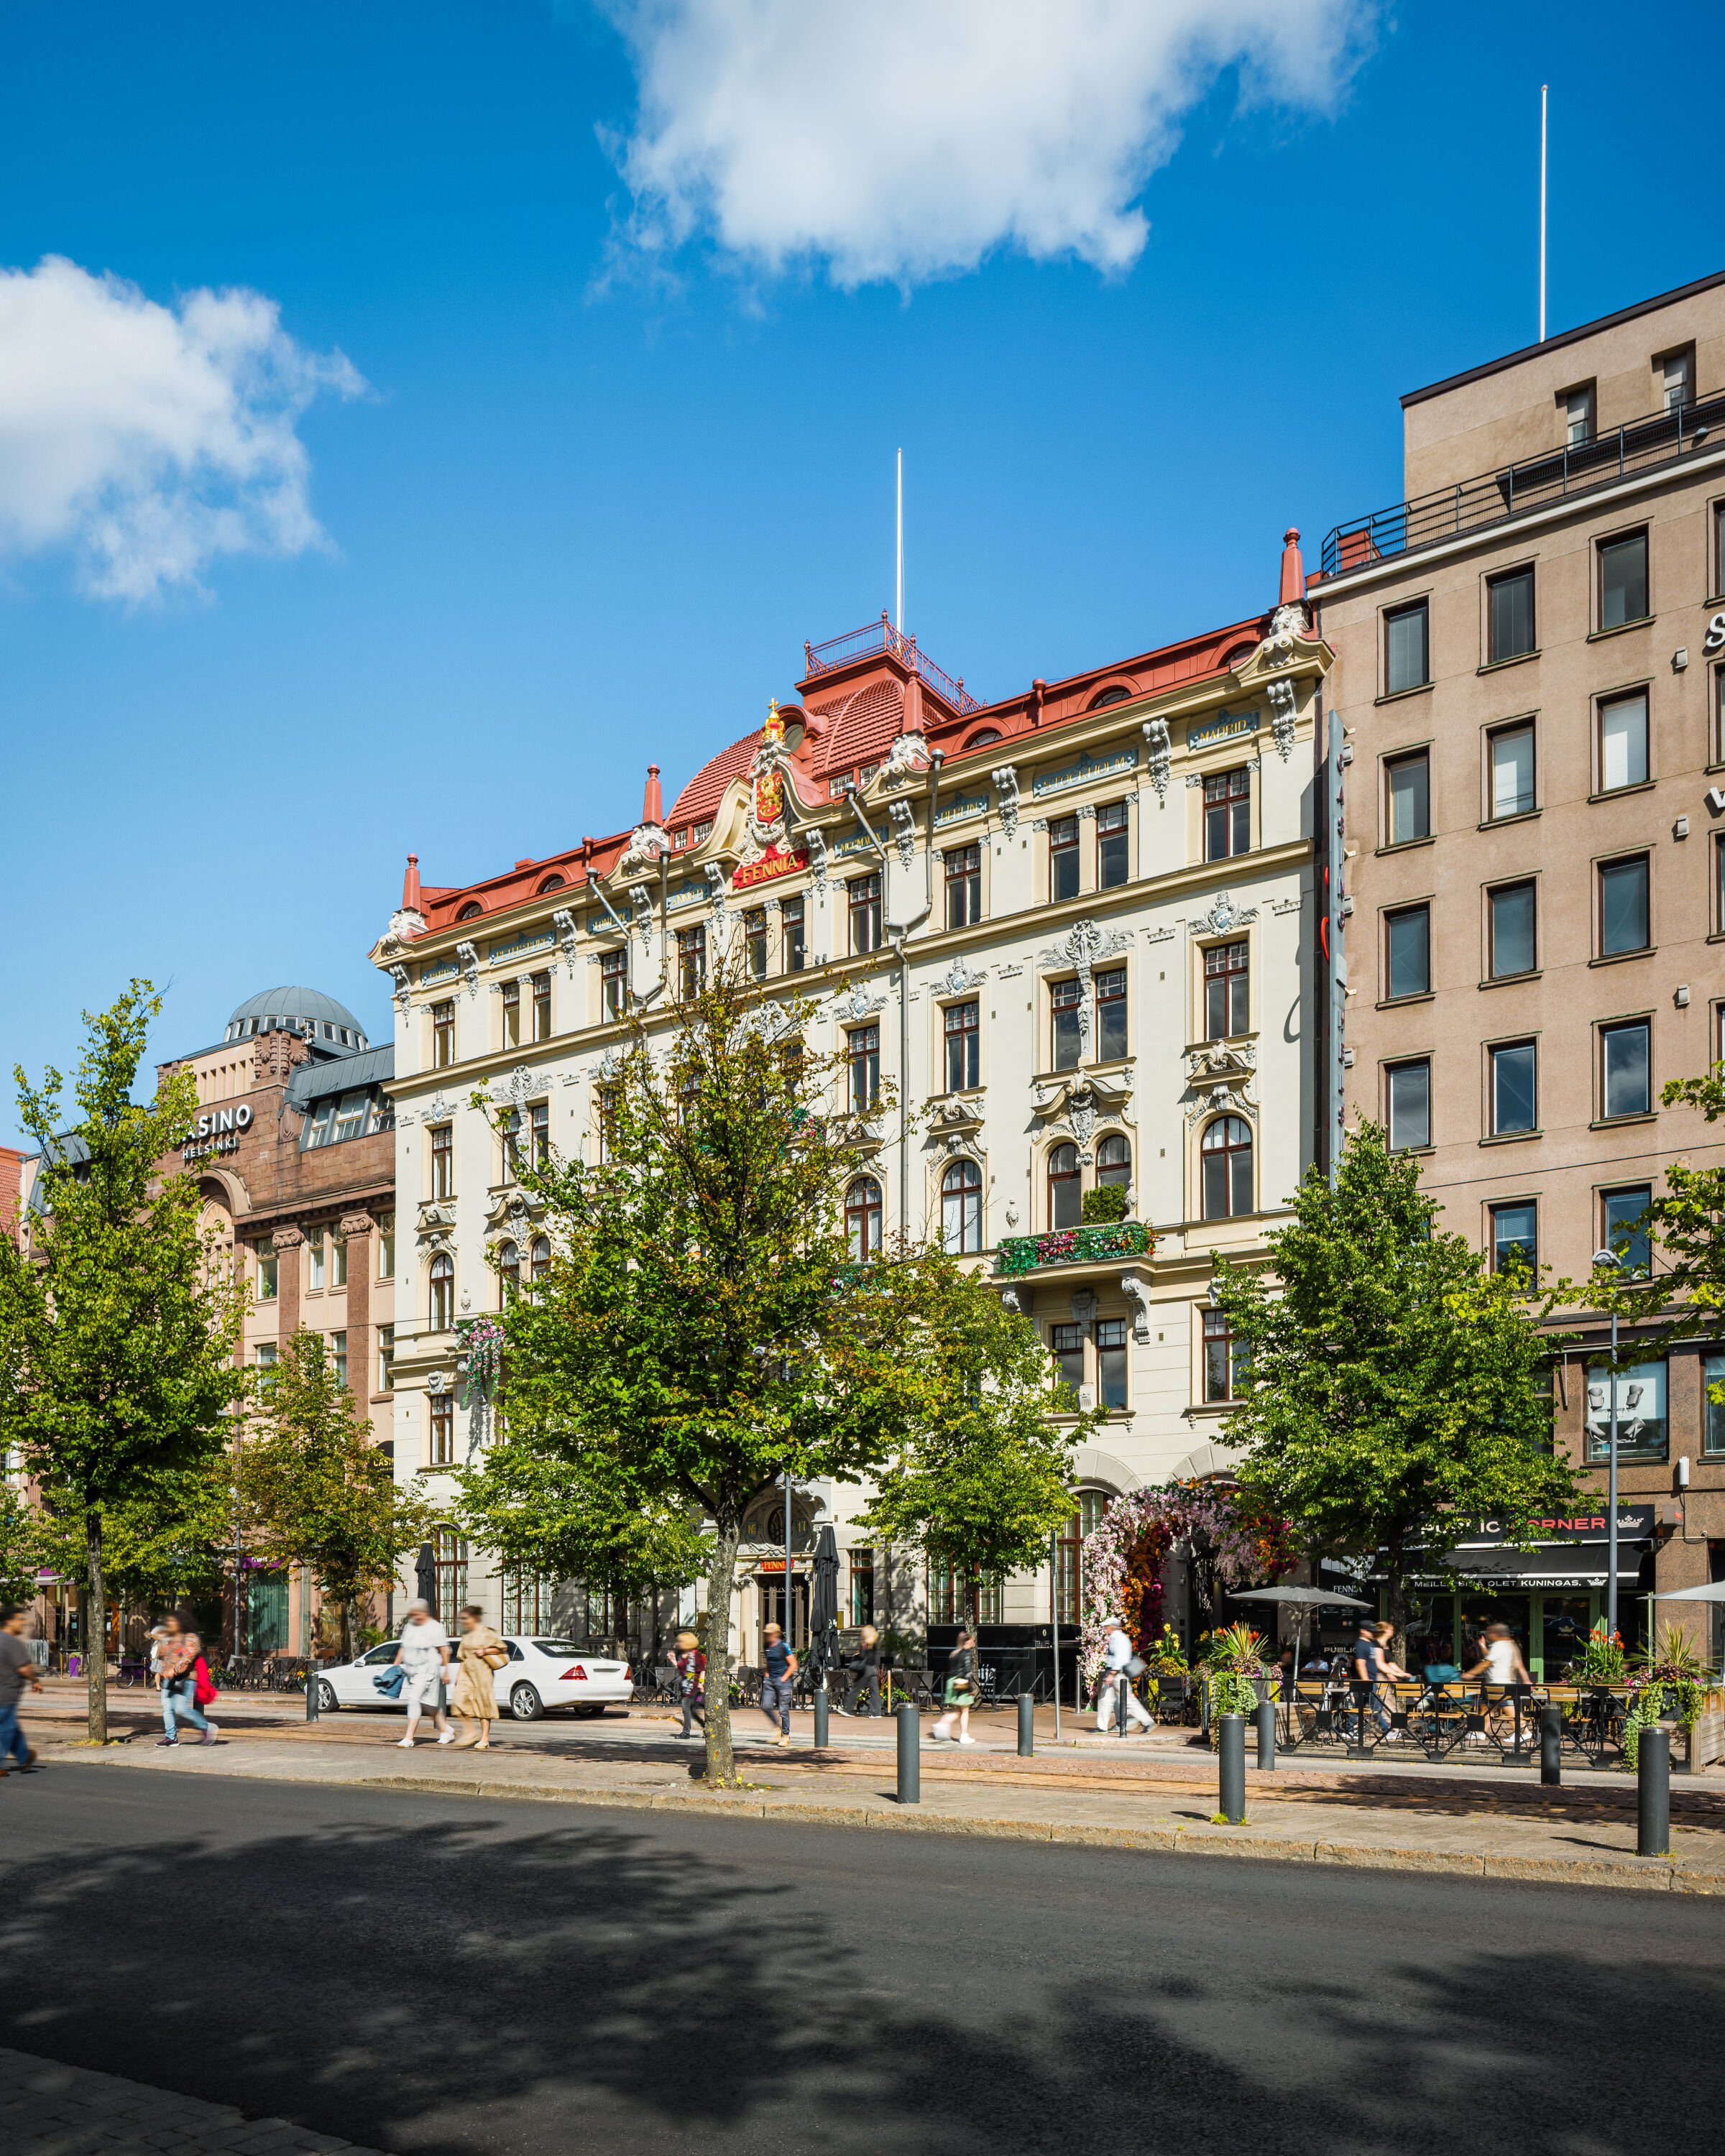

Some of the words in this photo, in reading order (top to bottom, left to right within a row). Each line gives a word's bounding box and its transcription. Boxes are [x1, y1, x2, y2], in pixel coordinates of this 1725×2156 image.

[1200, 719, 1247, 744] MADRID
[1044, 756, 1126, 791] STOCKHOLM
[941, 802, 978, 823] BERLIN
[840, 831, 881, 853] MCCMXCX
[1337, 753, 1346, 930] CASINO
[742, 854, 799, 884] FENNIA
[672, 890, 695, 905] ANNO
[496, 936, 551, 961] PETERSBURG
[429, 967, 452, 982] PARIS
[183, 1138, 237, 1159] HELSINKI
[764, 1560, 786, 1570] FENNI
